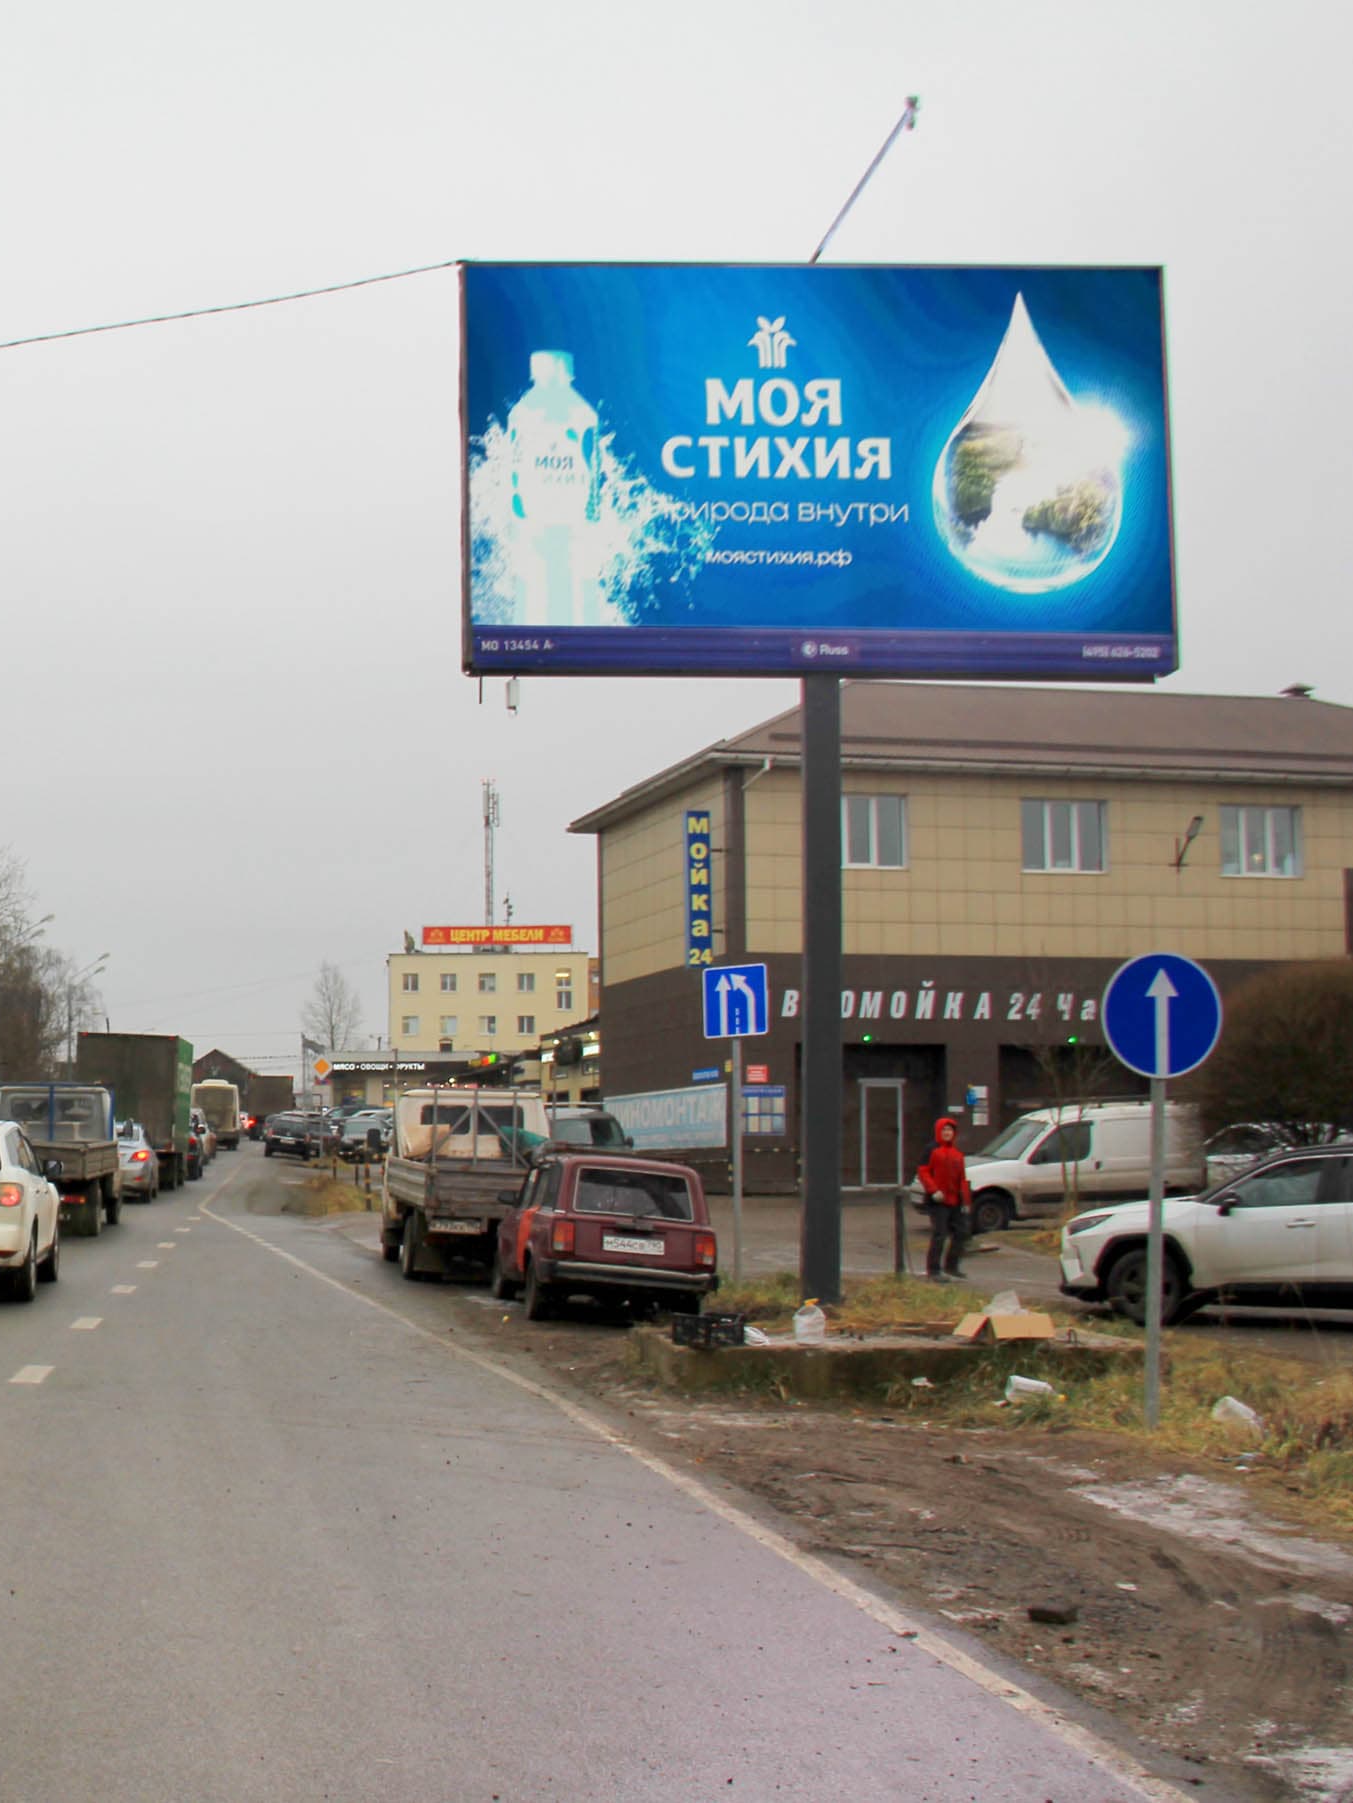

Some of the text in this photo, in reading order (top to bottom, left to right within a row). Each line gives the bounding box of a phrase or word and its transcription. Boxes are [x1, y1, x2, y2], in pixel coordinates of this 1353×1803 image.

[705, 377, 843, 427] МОЯ
[660, 434, 892, 480] СТИХИЯ
[652, 501, 910, 527] рирода внутри
[704, 548, 853, 568] моястихия.рф
[503, 639, 539, 650] 13454
[450, 928, 544, 943] ЦЕНТР МЕБЕЛИ
[688, 947, 713, 966] 24
[781, 979, 992, 1020] ВОМОЙКА
[1007, 992, 1042, 1021] 24
